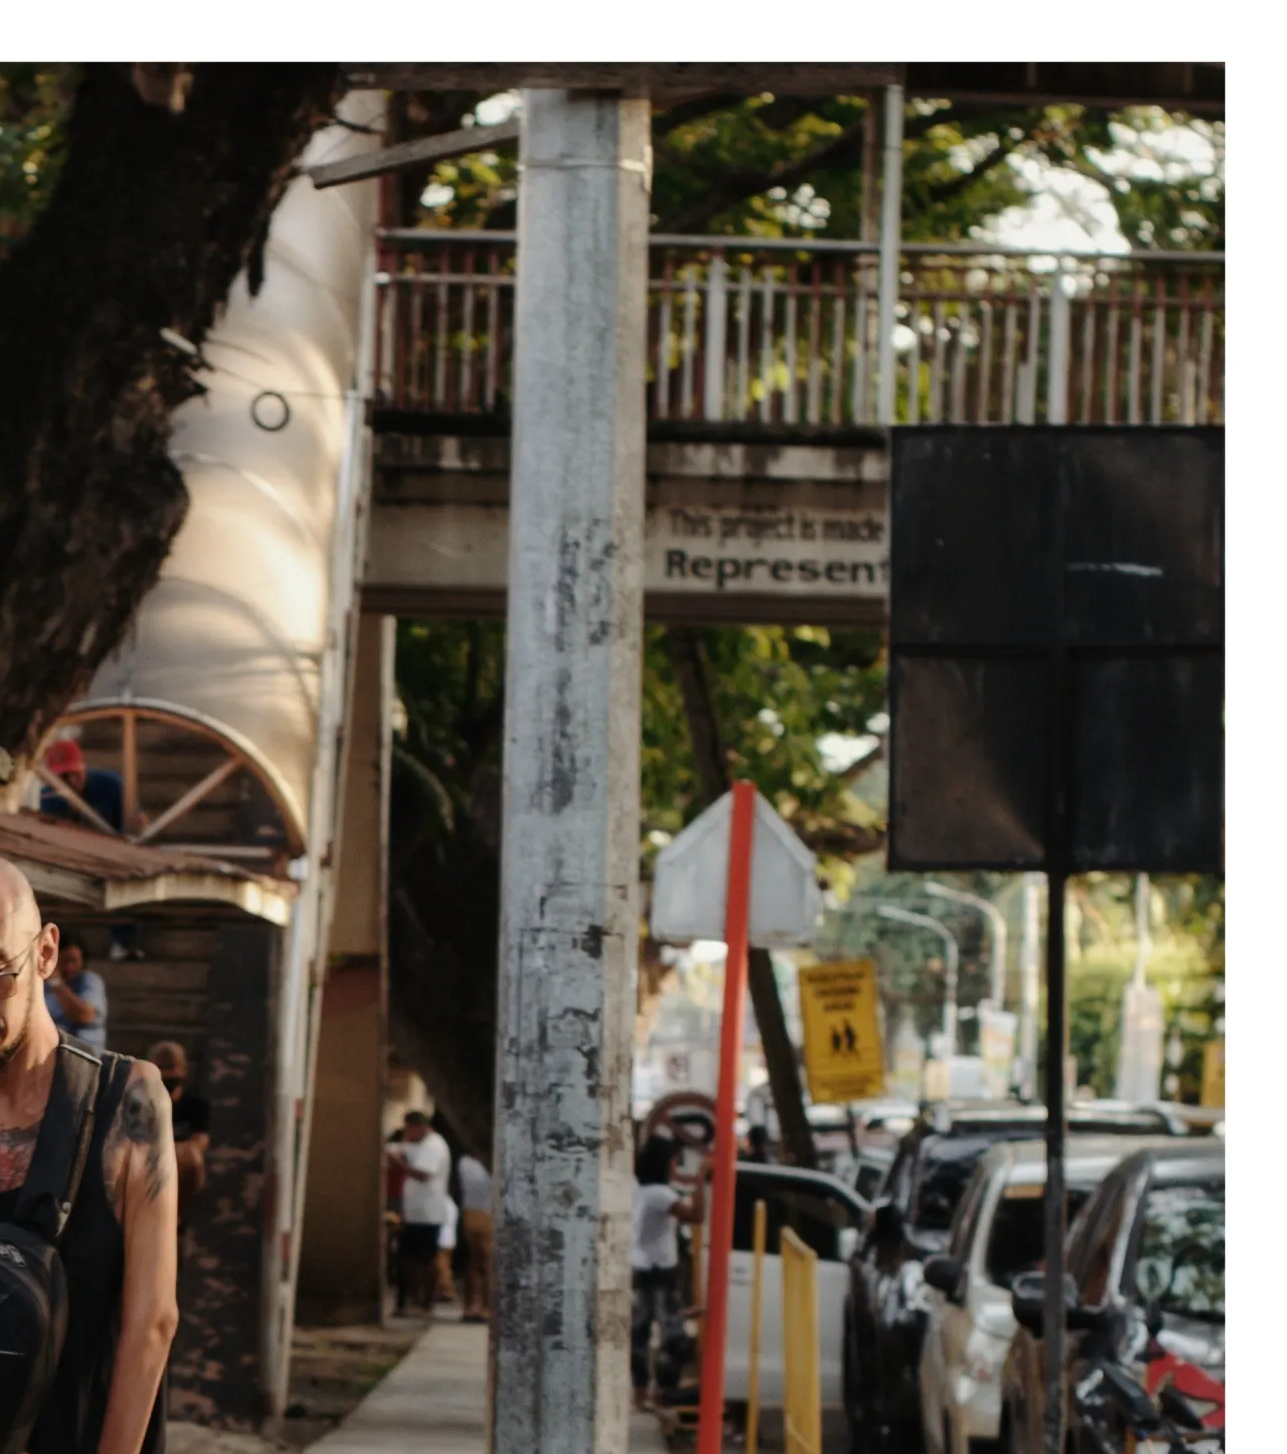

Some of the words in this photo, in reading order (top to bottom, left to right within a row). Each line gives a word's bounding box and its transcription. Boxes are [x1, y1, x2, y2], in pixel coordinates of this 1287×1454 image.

[669, 508, 714, 539] This
[718, 512, 797, 549] project
[821, 515, 885, 543] made
